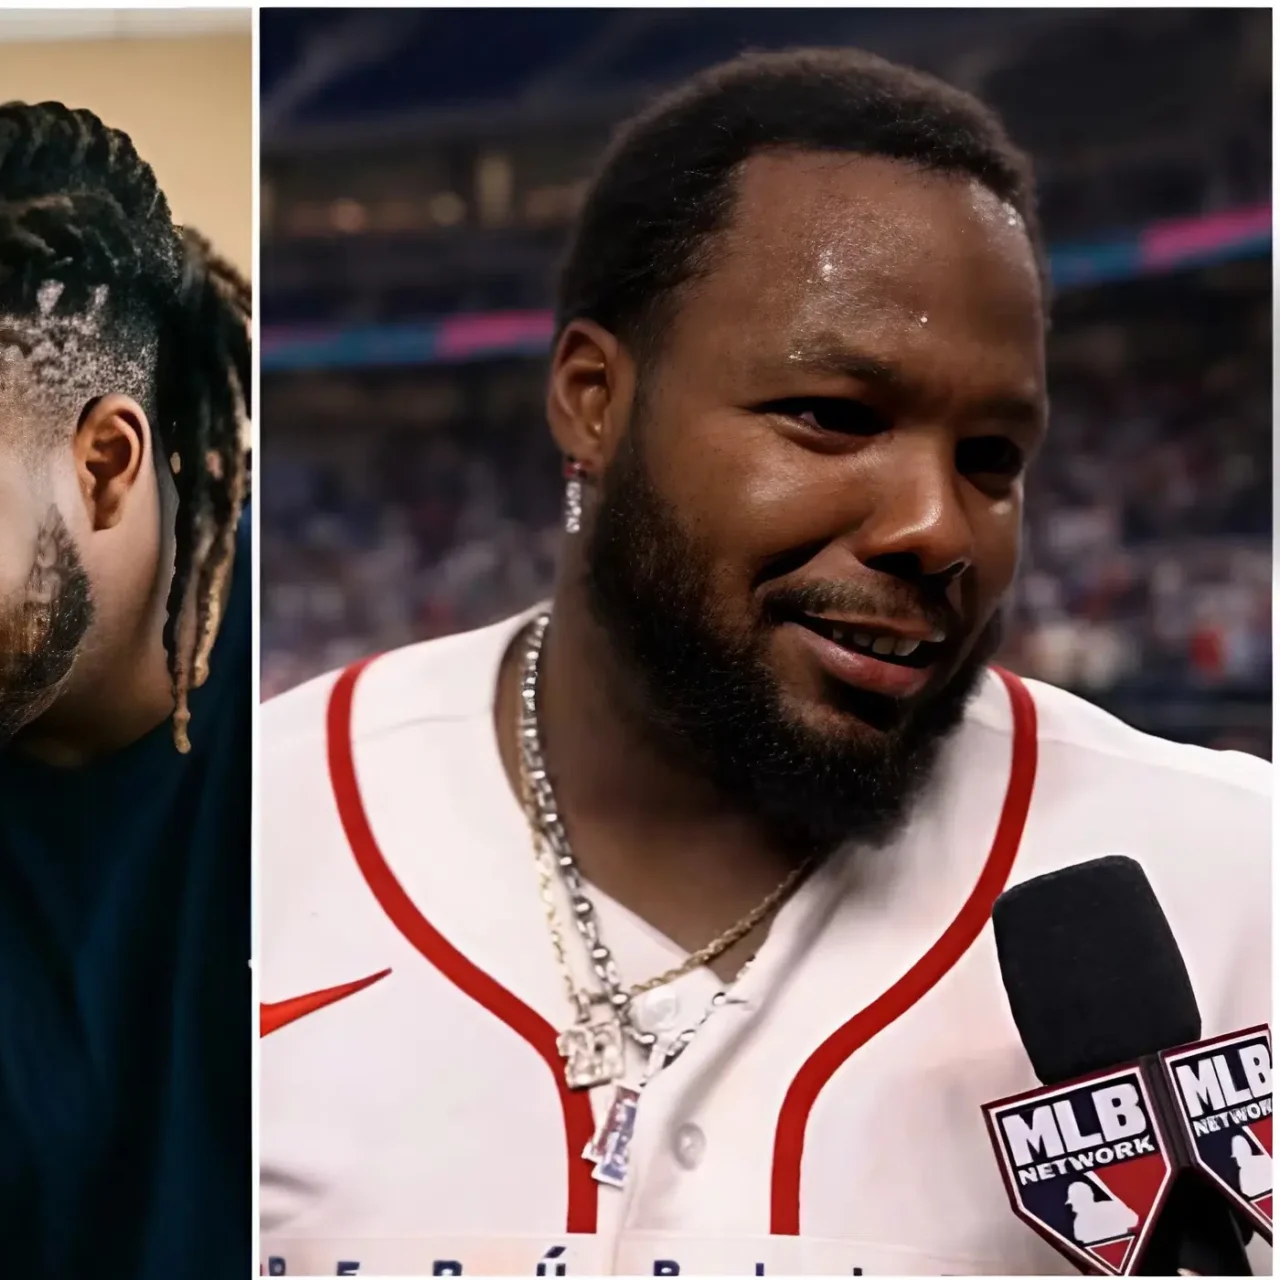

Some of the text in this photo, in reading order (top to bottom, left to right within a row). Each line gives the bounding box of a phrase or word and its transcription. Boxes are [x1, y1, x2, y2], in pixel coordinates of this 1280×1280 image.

[1173, 1043, 1272, 1118] MLB
[1001, 1083, 1146, 1167] MLB
[1018, 1135, 1155, 1185] NETWORK
